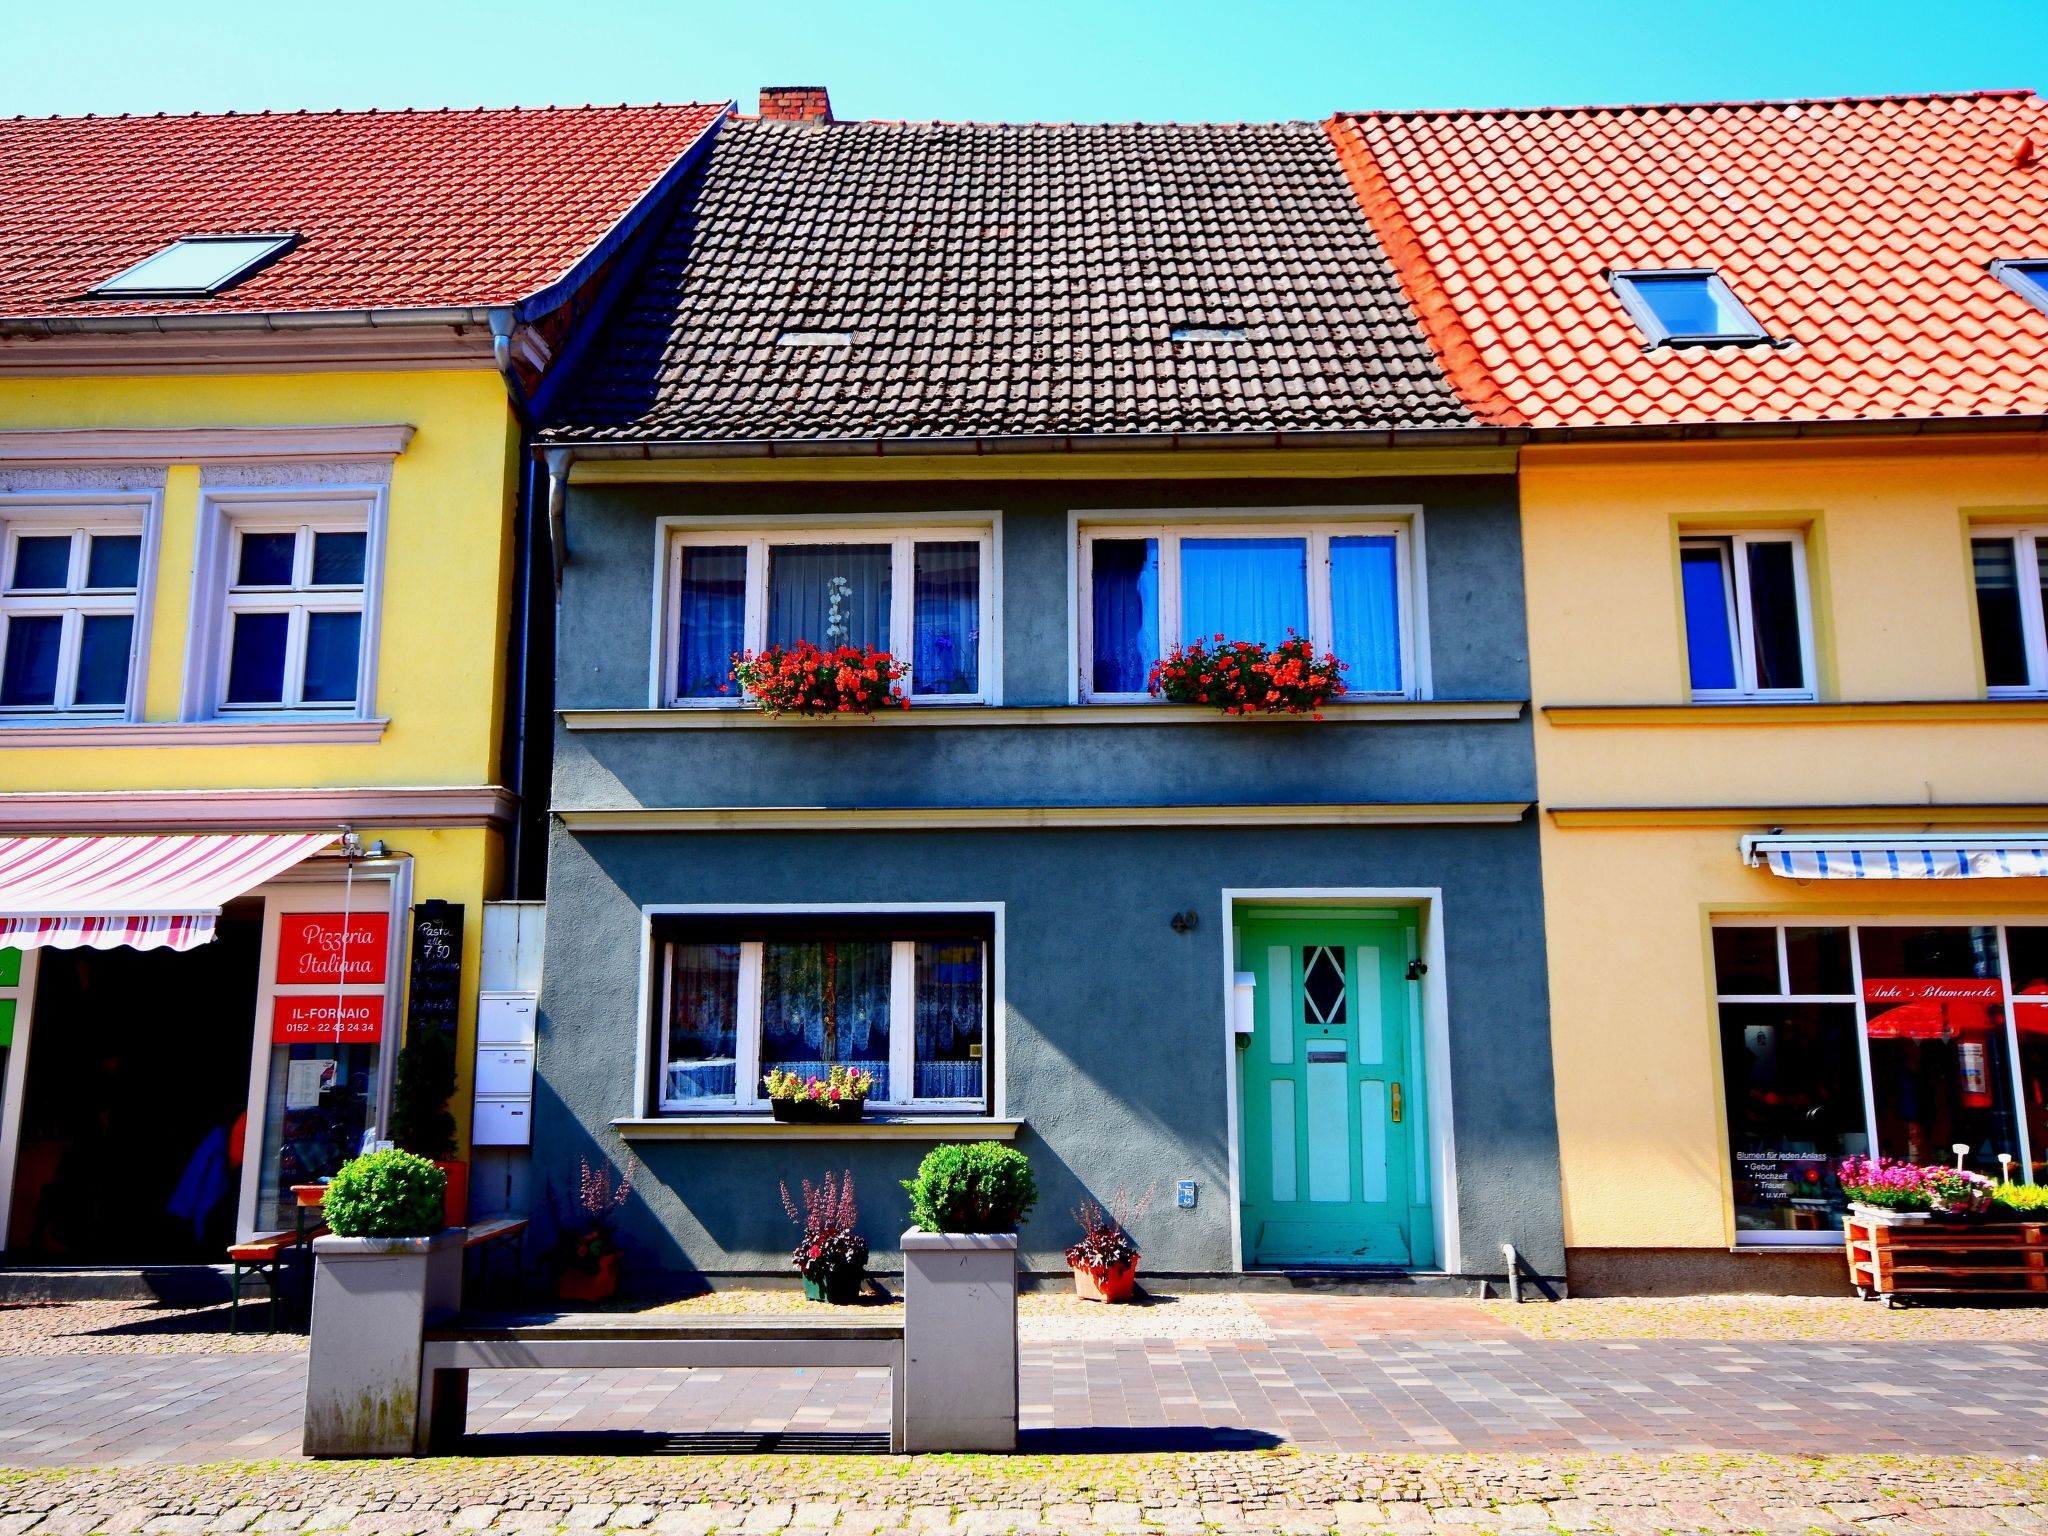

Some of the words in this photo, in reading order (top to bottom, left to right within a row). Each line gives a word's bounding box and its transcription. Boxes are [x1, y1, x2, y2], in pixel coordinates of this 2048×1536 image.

[418, 922, 453, 936] Pasta
[303, 925, 374, 951] Pizzeria
[300, 953, 373, 974] Italiana
[1918, 984, 1997, 998] Blumenecke
[292, 1008, 370, 1019] IL-FORNAIO
[286, 1023, 309, 1032] 0152
[318, 1023, 330, 1032] 22
[347, 1023, 359, 1032] 24
[361, 1023, 374, 1032] 34
[1736, 1151, 1766, 1160] Blumen
[1767, 1151, 1778, 1160] für
[1778, 1152, 1800, 1161] jeden
[1800, 1152, 1827, 1161] Anlass
